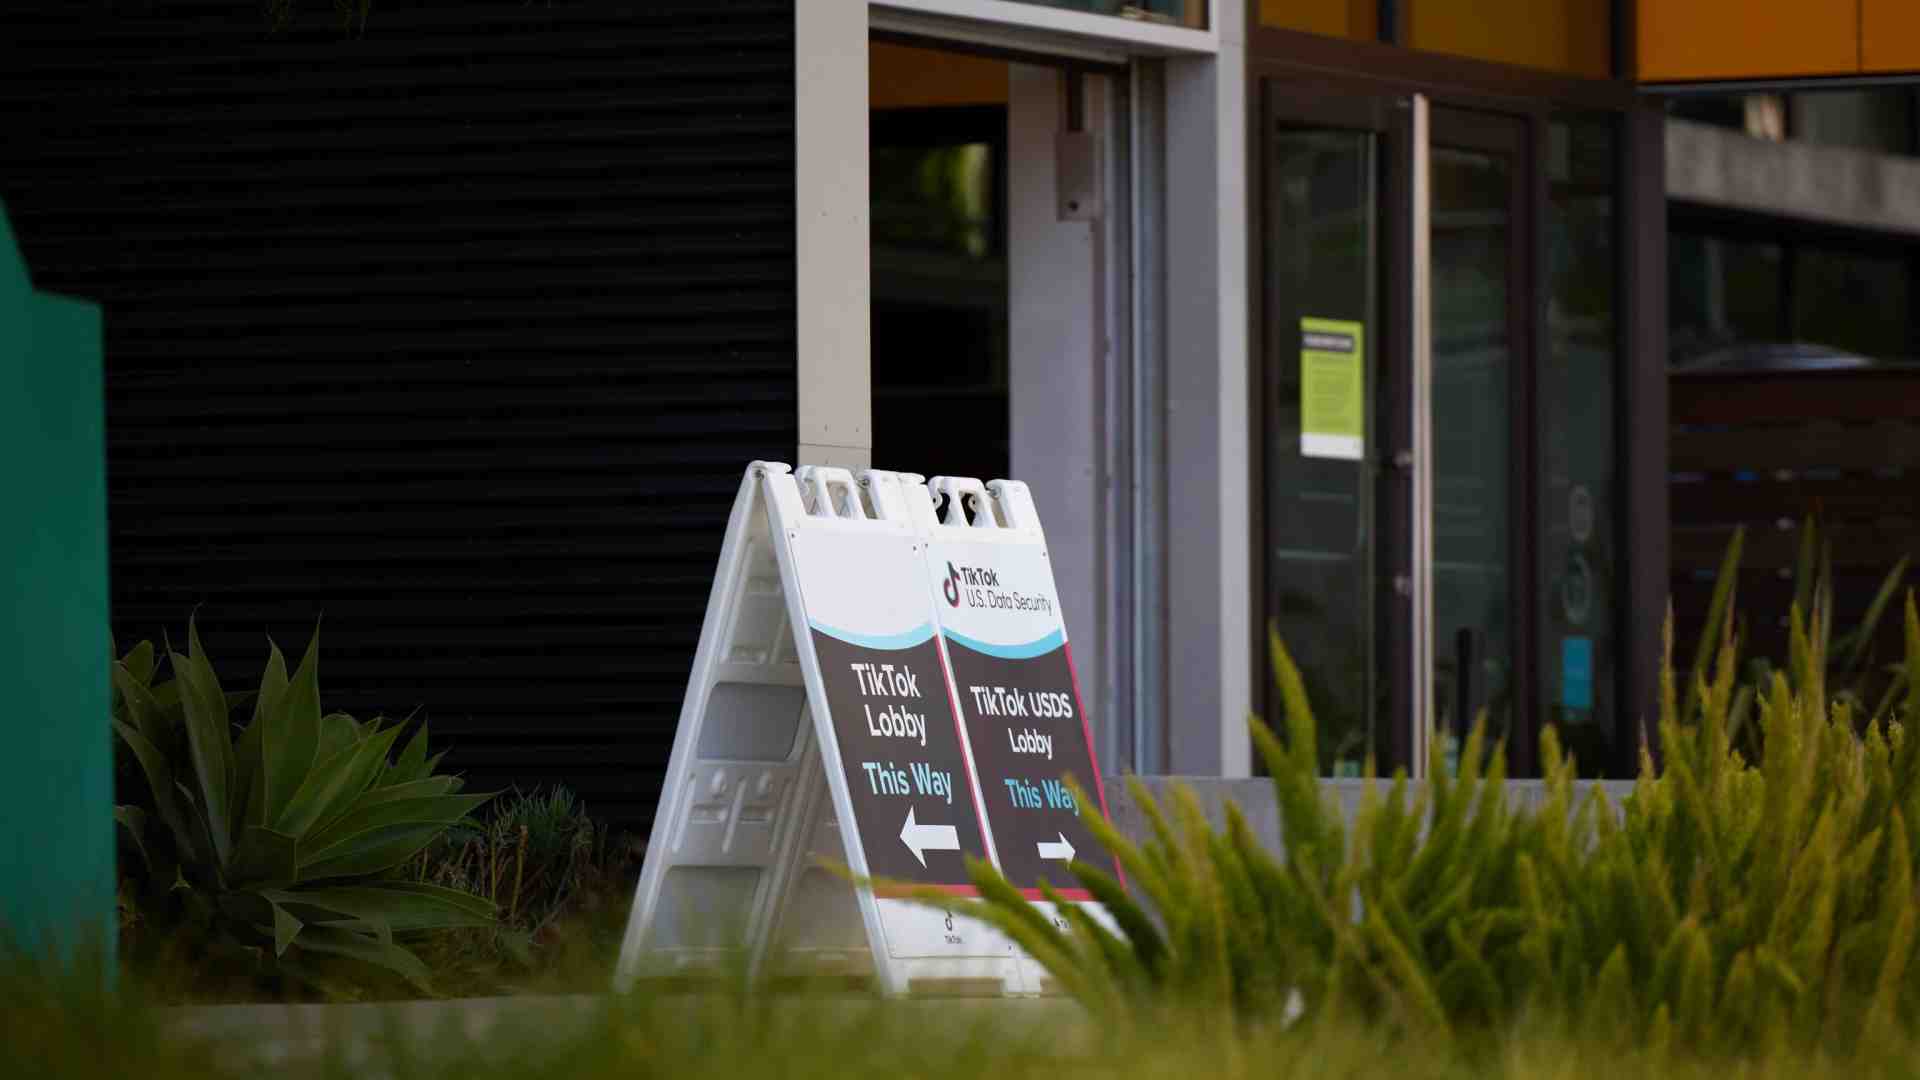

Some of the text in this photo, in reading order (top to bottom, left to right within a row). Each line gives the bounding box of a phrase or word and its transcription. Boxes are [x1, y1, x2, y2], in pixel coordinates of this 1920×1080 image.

[960, 567, 1000, 586] TikTok
[967, 590, 1053, 616] U.S. Data Security
[851, 663, 921, 698] TikTok
[970, 686, 1073, 718] TikTok USDS
[864, 704, 926, 746] Lobby
[1008, 728, 1052, 760] Lobby
[862, 762, 952, 805] This Way
[1004, 778, 1079, 816] This Way
